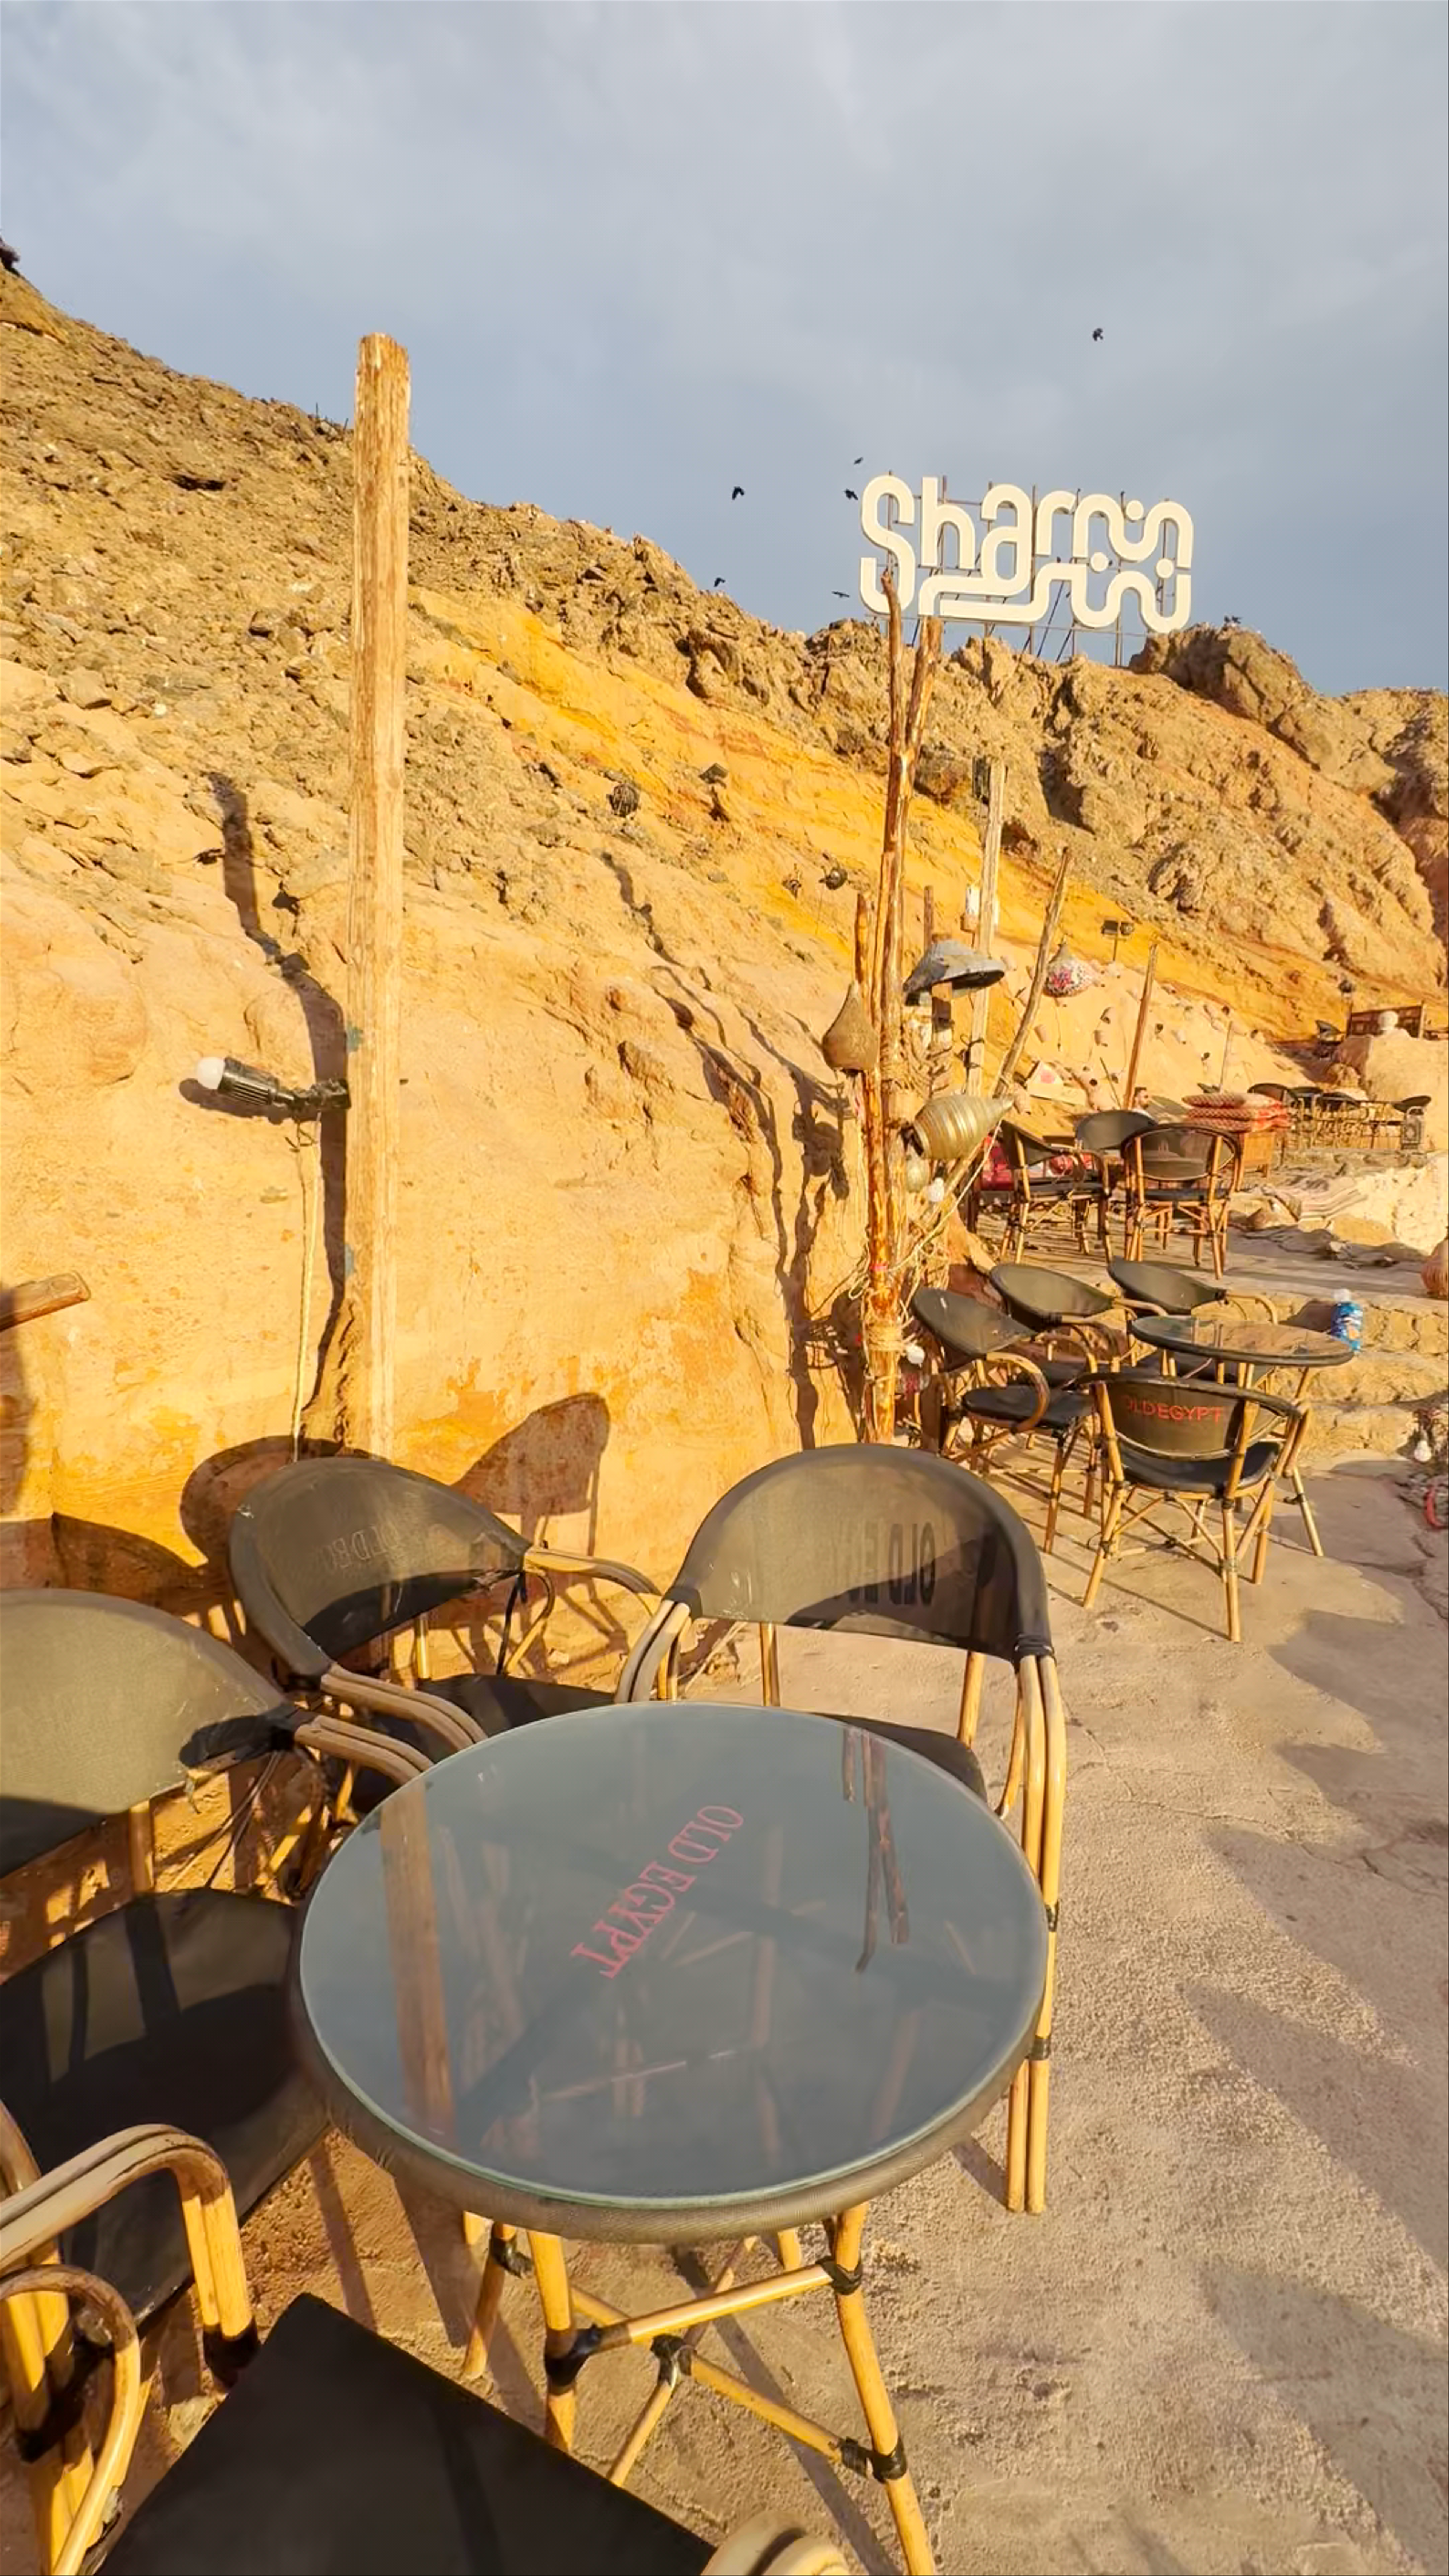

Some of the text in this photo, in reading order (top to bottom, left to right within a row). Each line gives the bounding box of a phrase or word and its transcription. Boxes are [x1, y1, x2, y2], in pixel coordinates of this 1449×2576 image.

[861, 475, 1193, 615] Sharm
[570, 1805, 744, 1979] OLD EGYPT
